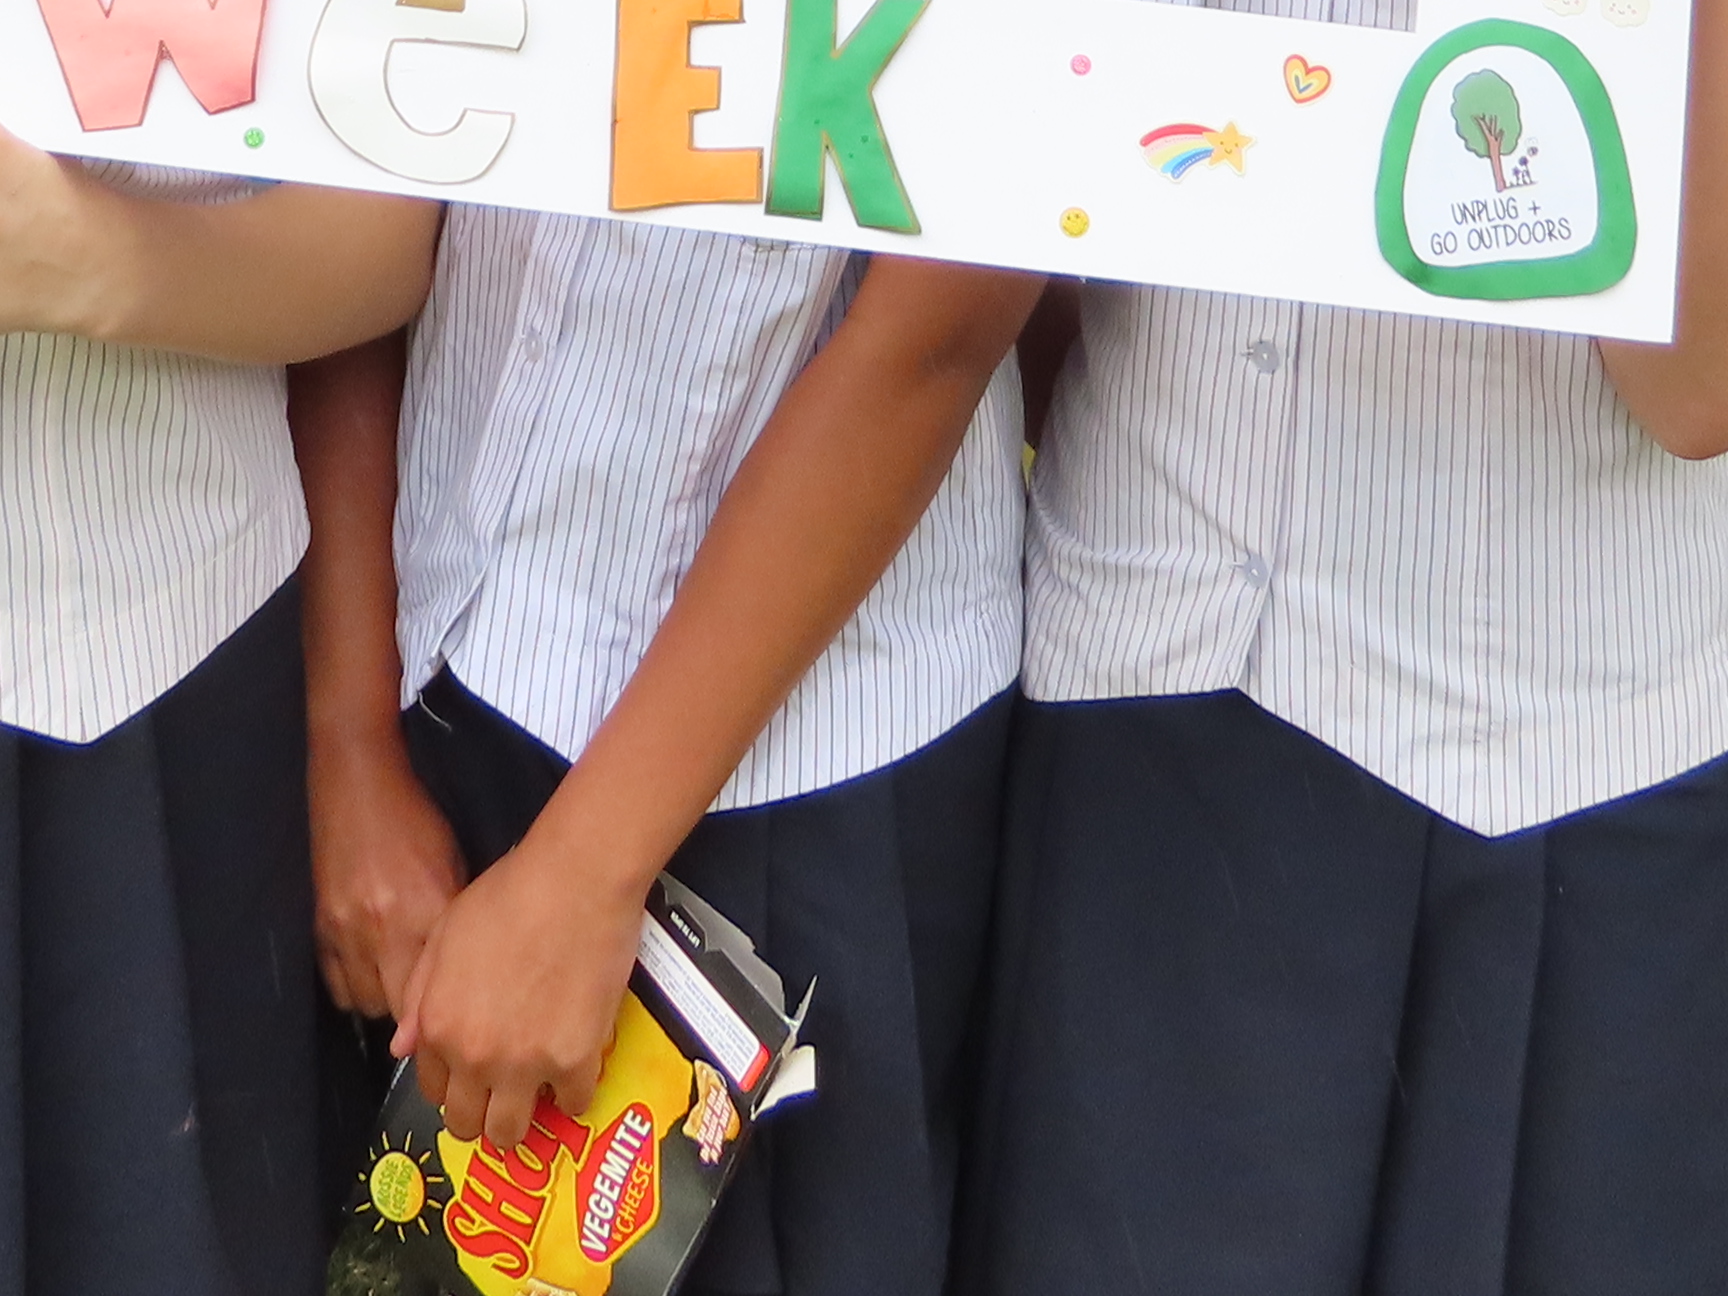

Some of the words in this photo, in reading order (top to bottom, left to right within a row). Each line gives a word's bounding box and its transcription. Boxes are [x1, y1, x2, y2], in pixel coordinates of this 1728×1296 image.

[1430, 232, 1459, 256] GO
[1467, 217, 1572, 251] OUTDOORS
[1451, 197, 1519, 227] UNPLUG
[580, 1108, 653, 1254] VEGEMITE
[615, 1157, 654, 1235] CHEESE
